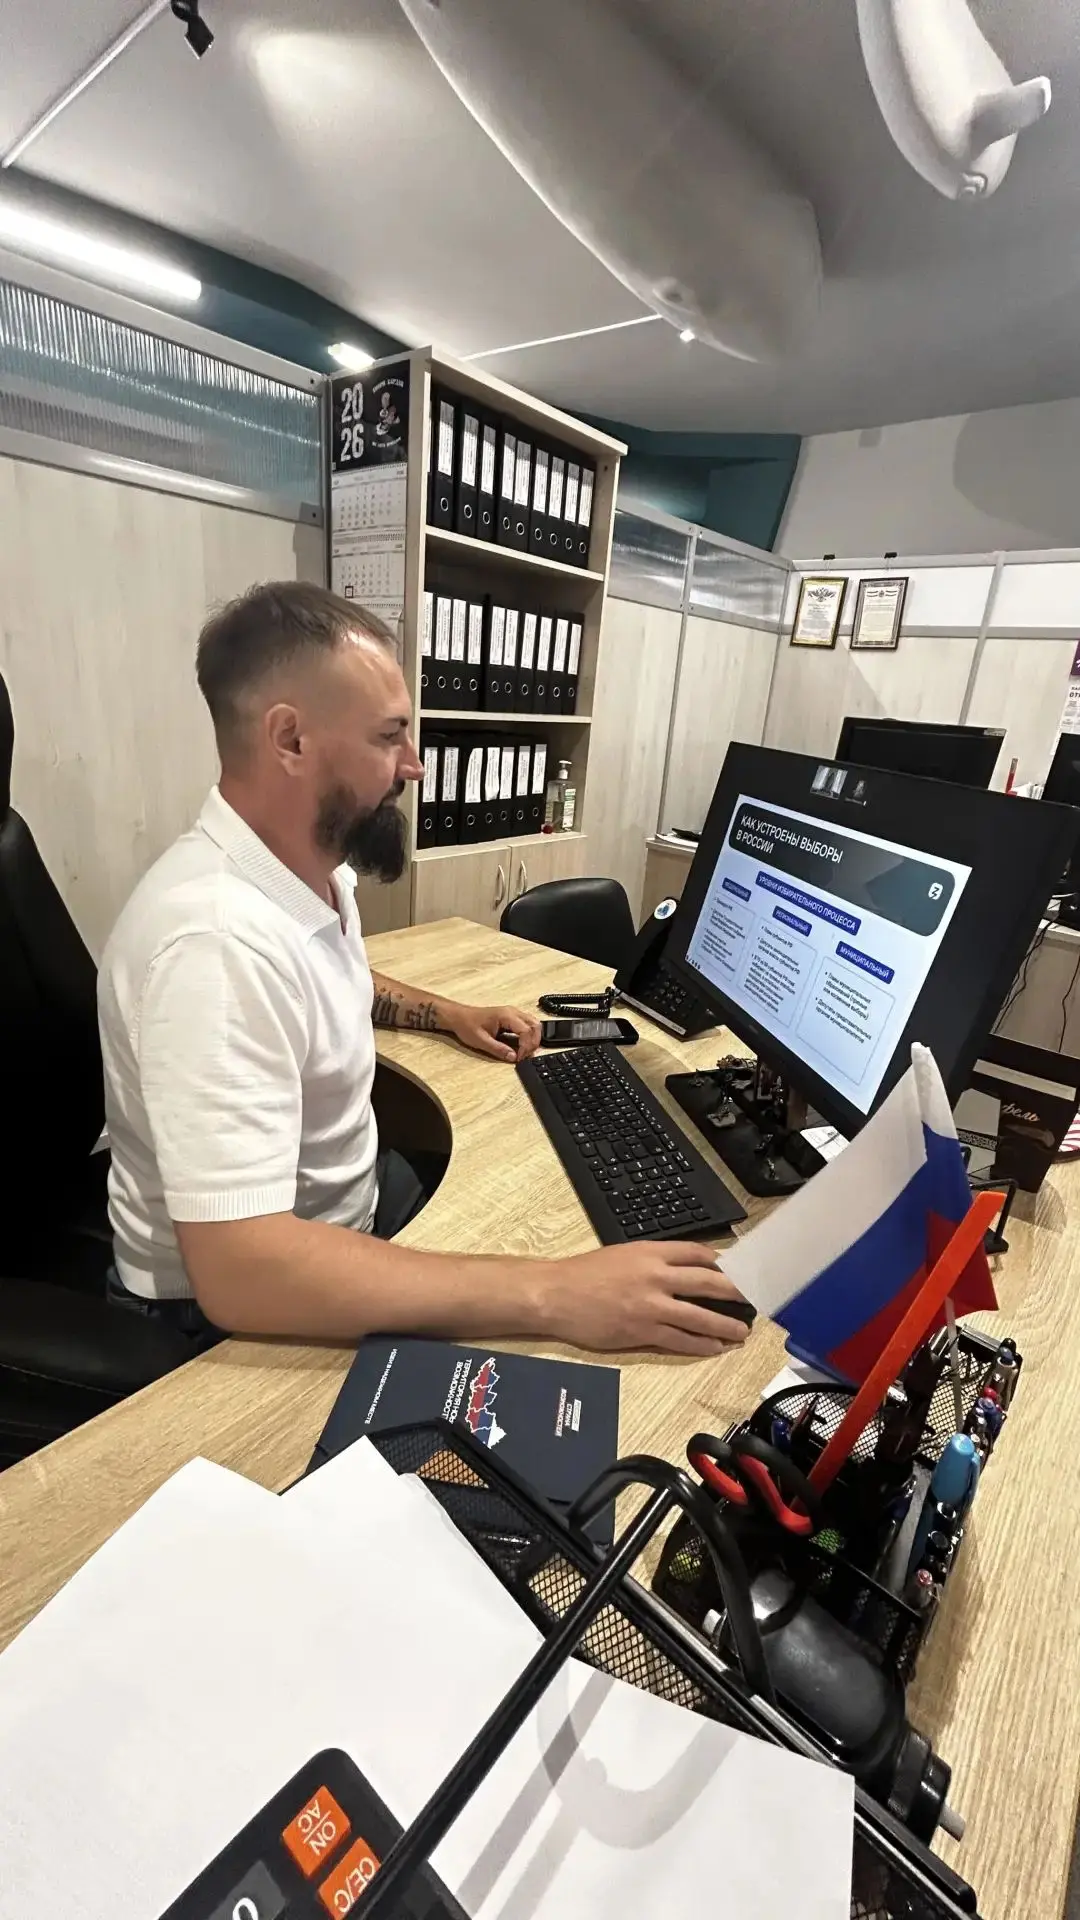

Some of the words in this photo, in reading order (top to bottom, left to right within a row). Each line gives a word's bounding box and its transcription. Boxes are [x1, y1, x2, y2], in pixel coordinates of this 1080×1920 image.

[341, 382, 364, 424] 20
[340, 423, 364, 462] 26
[735, 829, 742, 840] В
[741, 831, 774, 853] РОССИИ
[740, 815, 757, 829] КАК
[755, 820, 800, 846] УСТРОЕНЫ
[799, 836, 843, 863] ВЫБОРЫ
[758, 875, 777, 889] УРОВНИ
[776, 885, 823, 913] ИЗБИРАТЕЛЬНОГО
[822, 907, 855, 930] ПРОЦЕССА
[839, 945, 889, 978] МУНИЦИПАЛЬНЫЙ
[1002, 1102, 1041, 1122] фель
[441, 1361, 464, 1420] ВОЗМОЖНОСТ
[454, 1358, 472, 1406] ТЕРРИТОРИЯ
[449, 1406, 460, 1424] НОВ
[298, 1799, 321, 1833] AC
[309, 1821, 336, 1856] ON
[334, 1857, 376, 1913] CE/C
